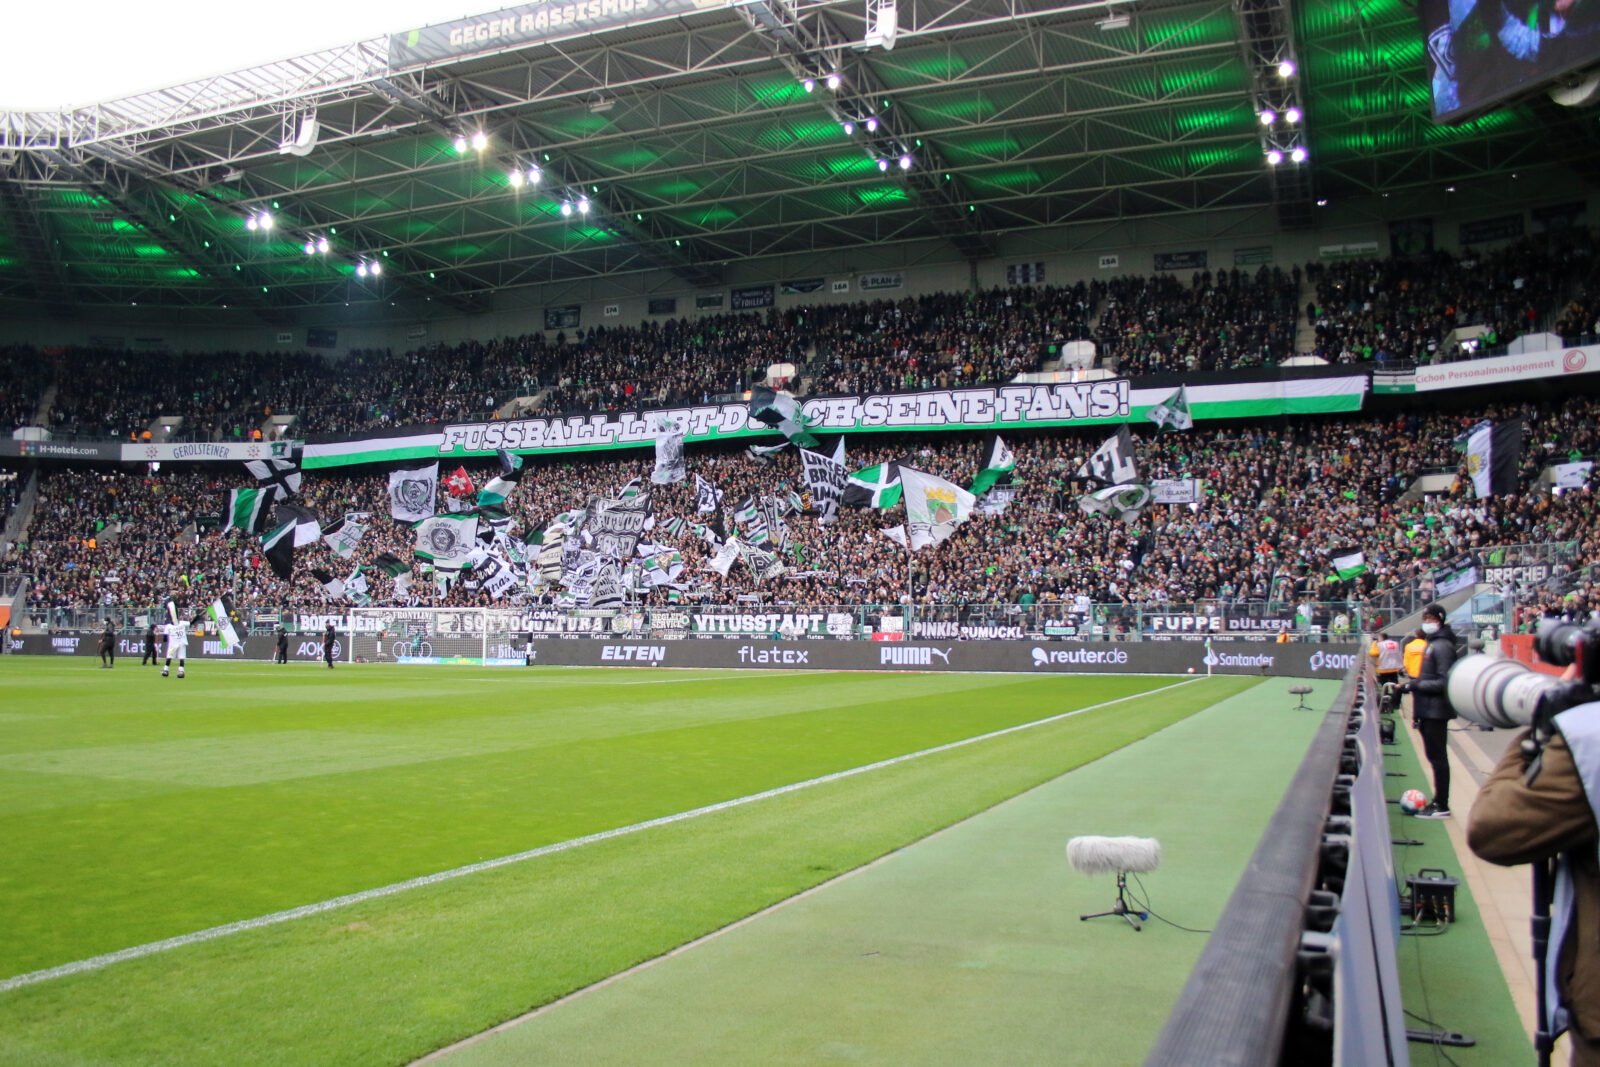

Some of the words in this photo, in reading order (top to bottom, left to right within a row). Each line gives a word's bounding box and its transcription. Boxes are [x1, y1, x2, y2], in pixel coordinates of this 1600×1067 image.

[450, 17, 516, 46] GEGEN
[1415, 373, 1446, 384] Cichon
[1448, 359, 1555, 380] Personalmanagement
[440, 411, 615, 451] FUSSBALL
[717, 397, 859, 434] DCH
[861, 388, 996, 428] SEINE
[999, 380, 1130, 423] FANS!
[39, 444, 98, 456] H-Hotels.com
[173, 442, 230, 459] GEROLSTEINER
[693, 614, 824, 632] VITUSSTADT
[913, 621, 959, 637] PINKIS
[1152, 616, 1221, 630] FUPPE
[1229, 618, 1293, 629] DÜLKEN
[52, 637, 80, 647] UNIBET
[119, 640, 162, 653] flatx
[296, 641, 325, 656] AOK
[601, 645, 666, 660] ELTEN
[738, 645, 809, 664] flatex
[880, 647, 931, 665] PUMA
[1050, 648, 1128, 664] reuter.de
[1218, 652, 1275, 667] Santander
